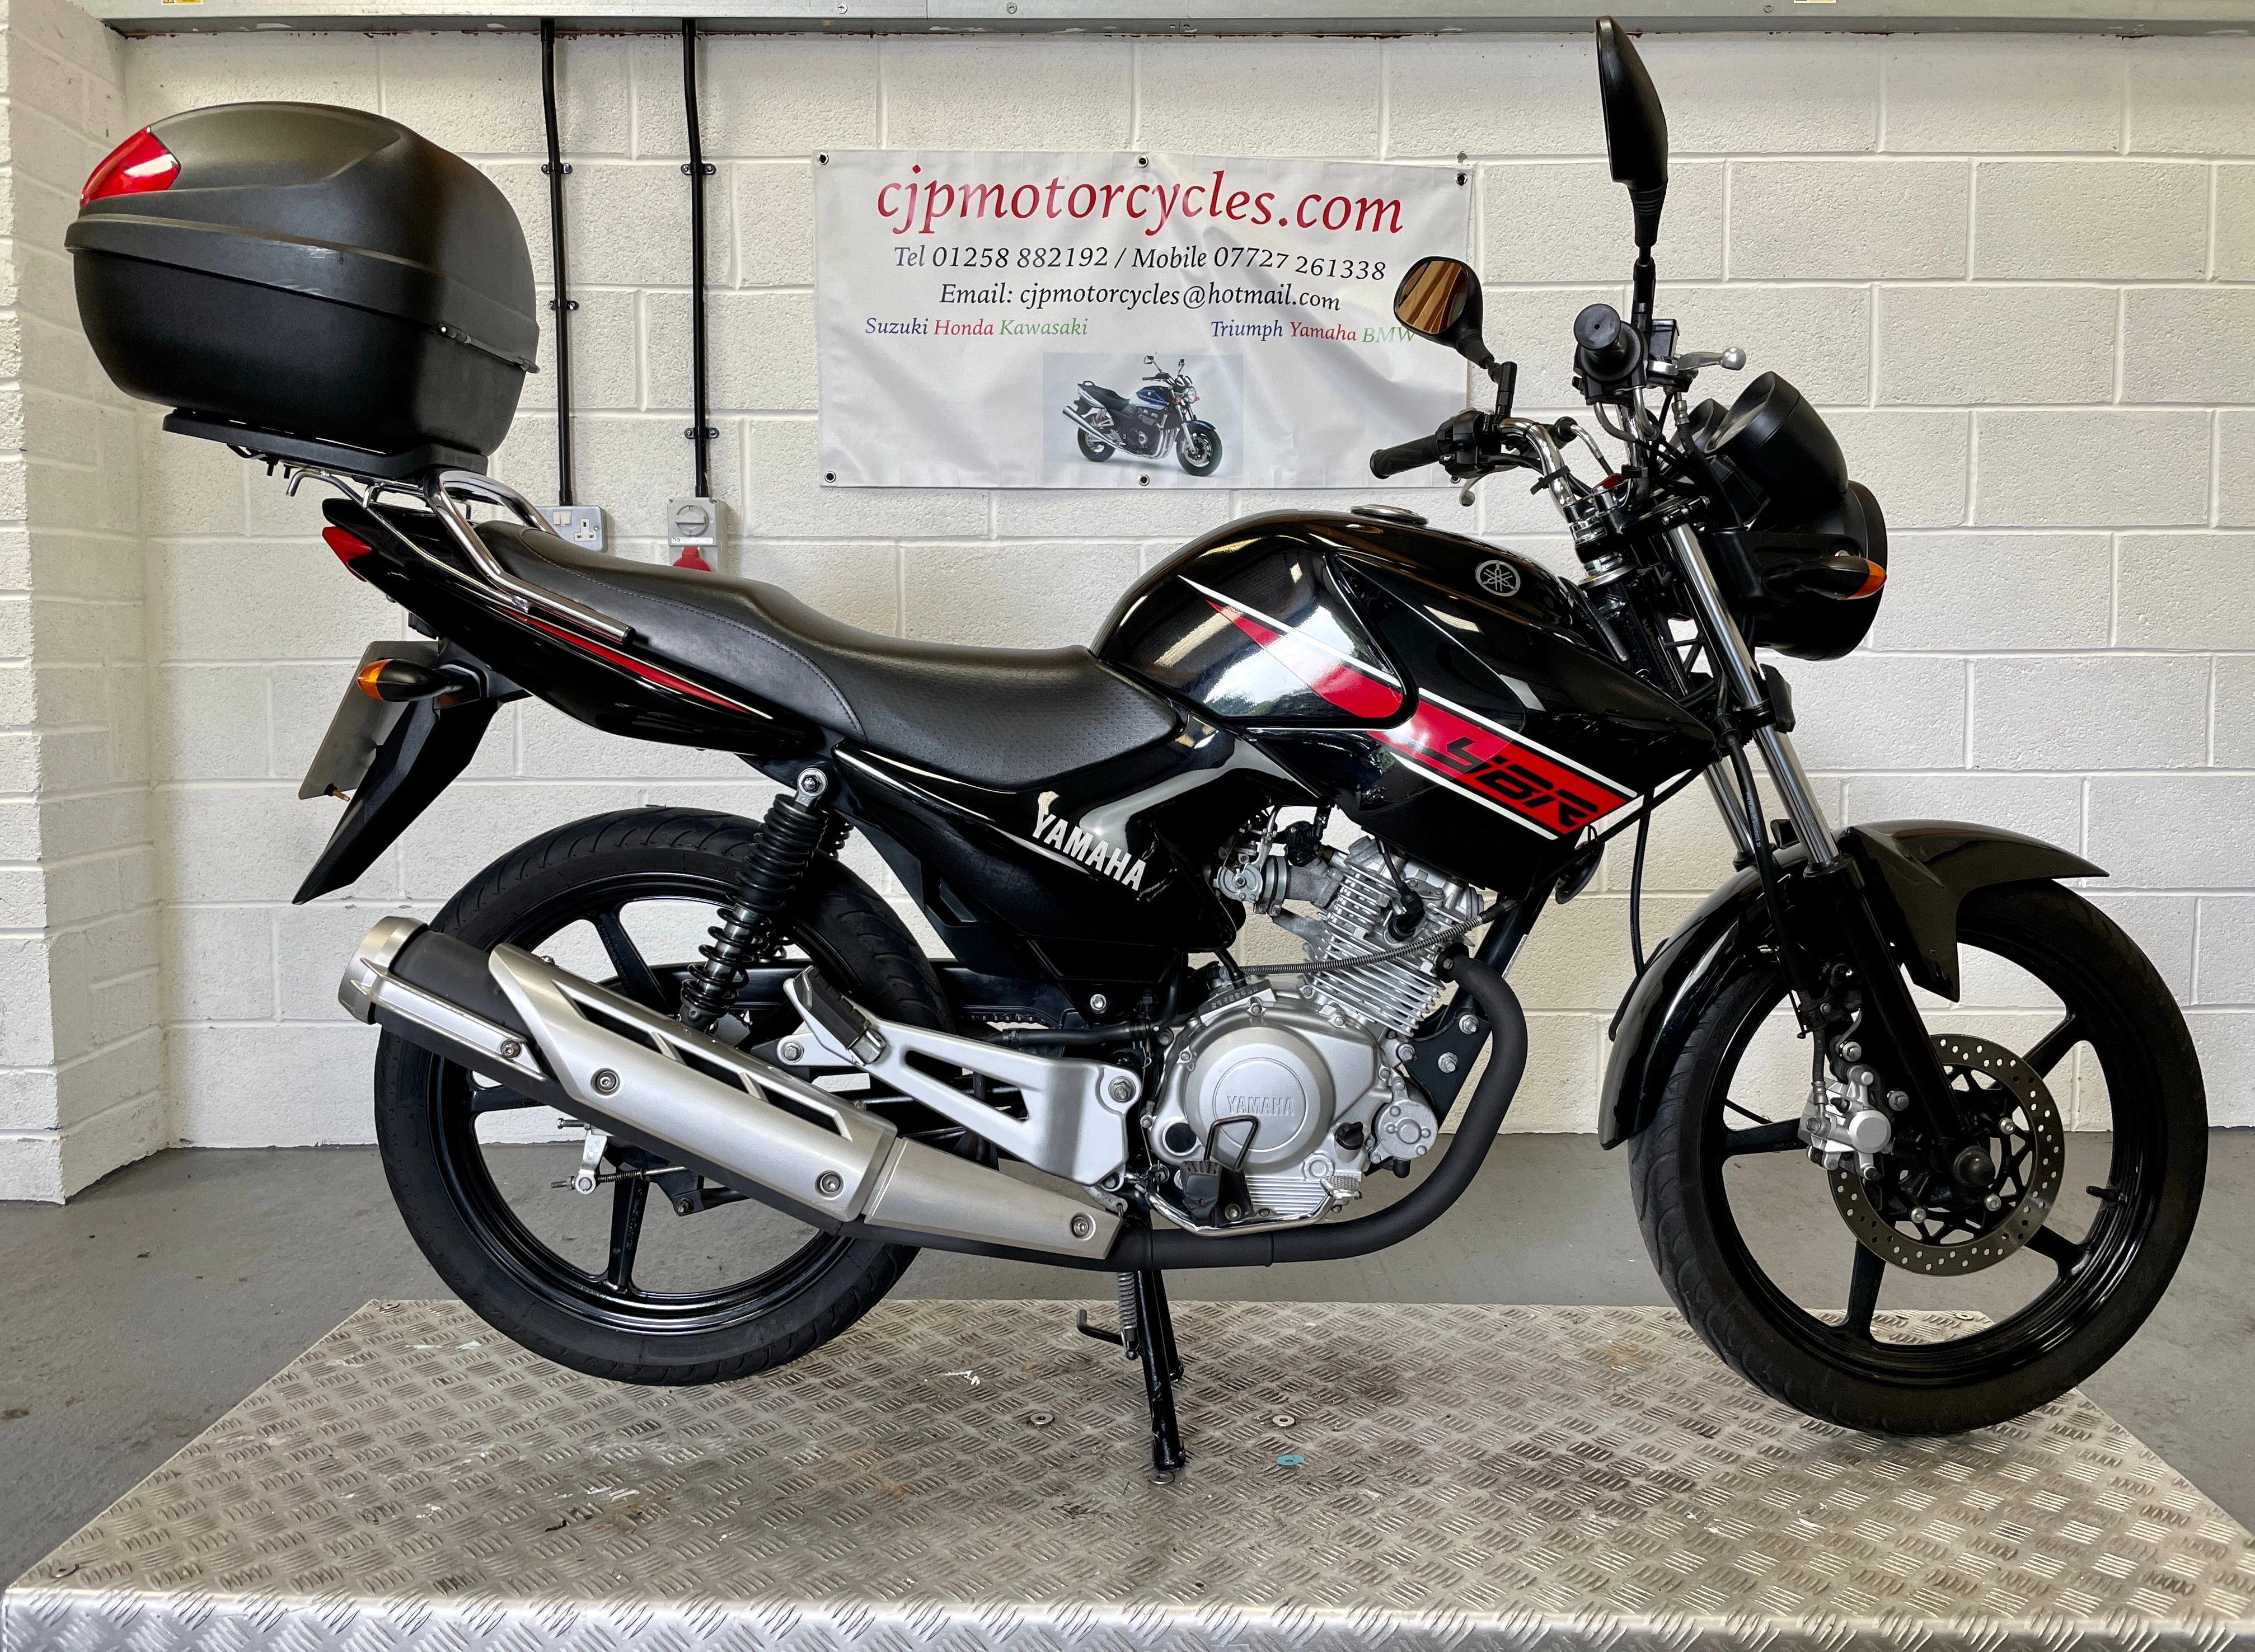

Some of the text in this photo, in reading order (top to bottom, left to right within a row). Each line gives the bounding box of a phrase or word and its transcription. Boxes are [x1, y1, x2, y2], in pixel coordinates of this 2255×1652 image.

[876, 163, 1404, 237] cjpmotorcycles.com
[894, 245, 1386, 280] Tel 01258 882192 / Mobile 07727 261338
[939, 281, 1341, 311] Email: cjpmotorcycles@hotmail.com
[865, 317, 1089, 336] Suzuki Honda Kawasaki
[1211, 320, 1283, 342] Triumph
[1289, 321, 1357, 342] Yamaha
[1446, 736, 1599, 828] YBR
[1032, 810, 1146, 891] YAMAHA
[1227, 1095, 1295, 1116] YAMAHA
